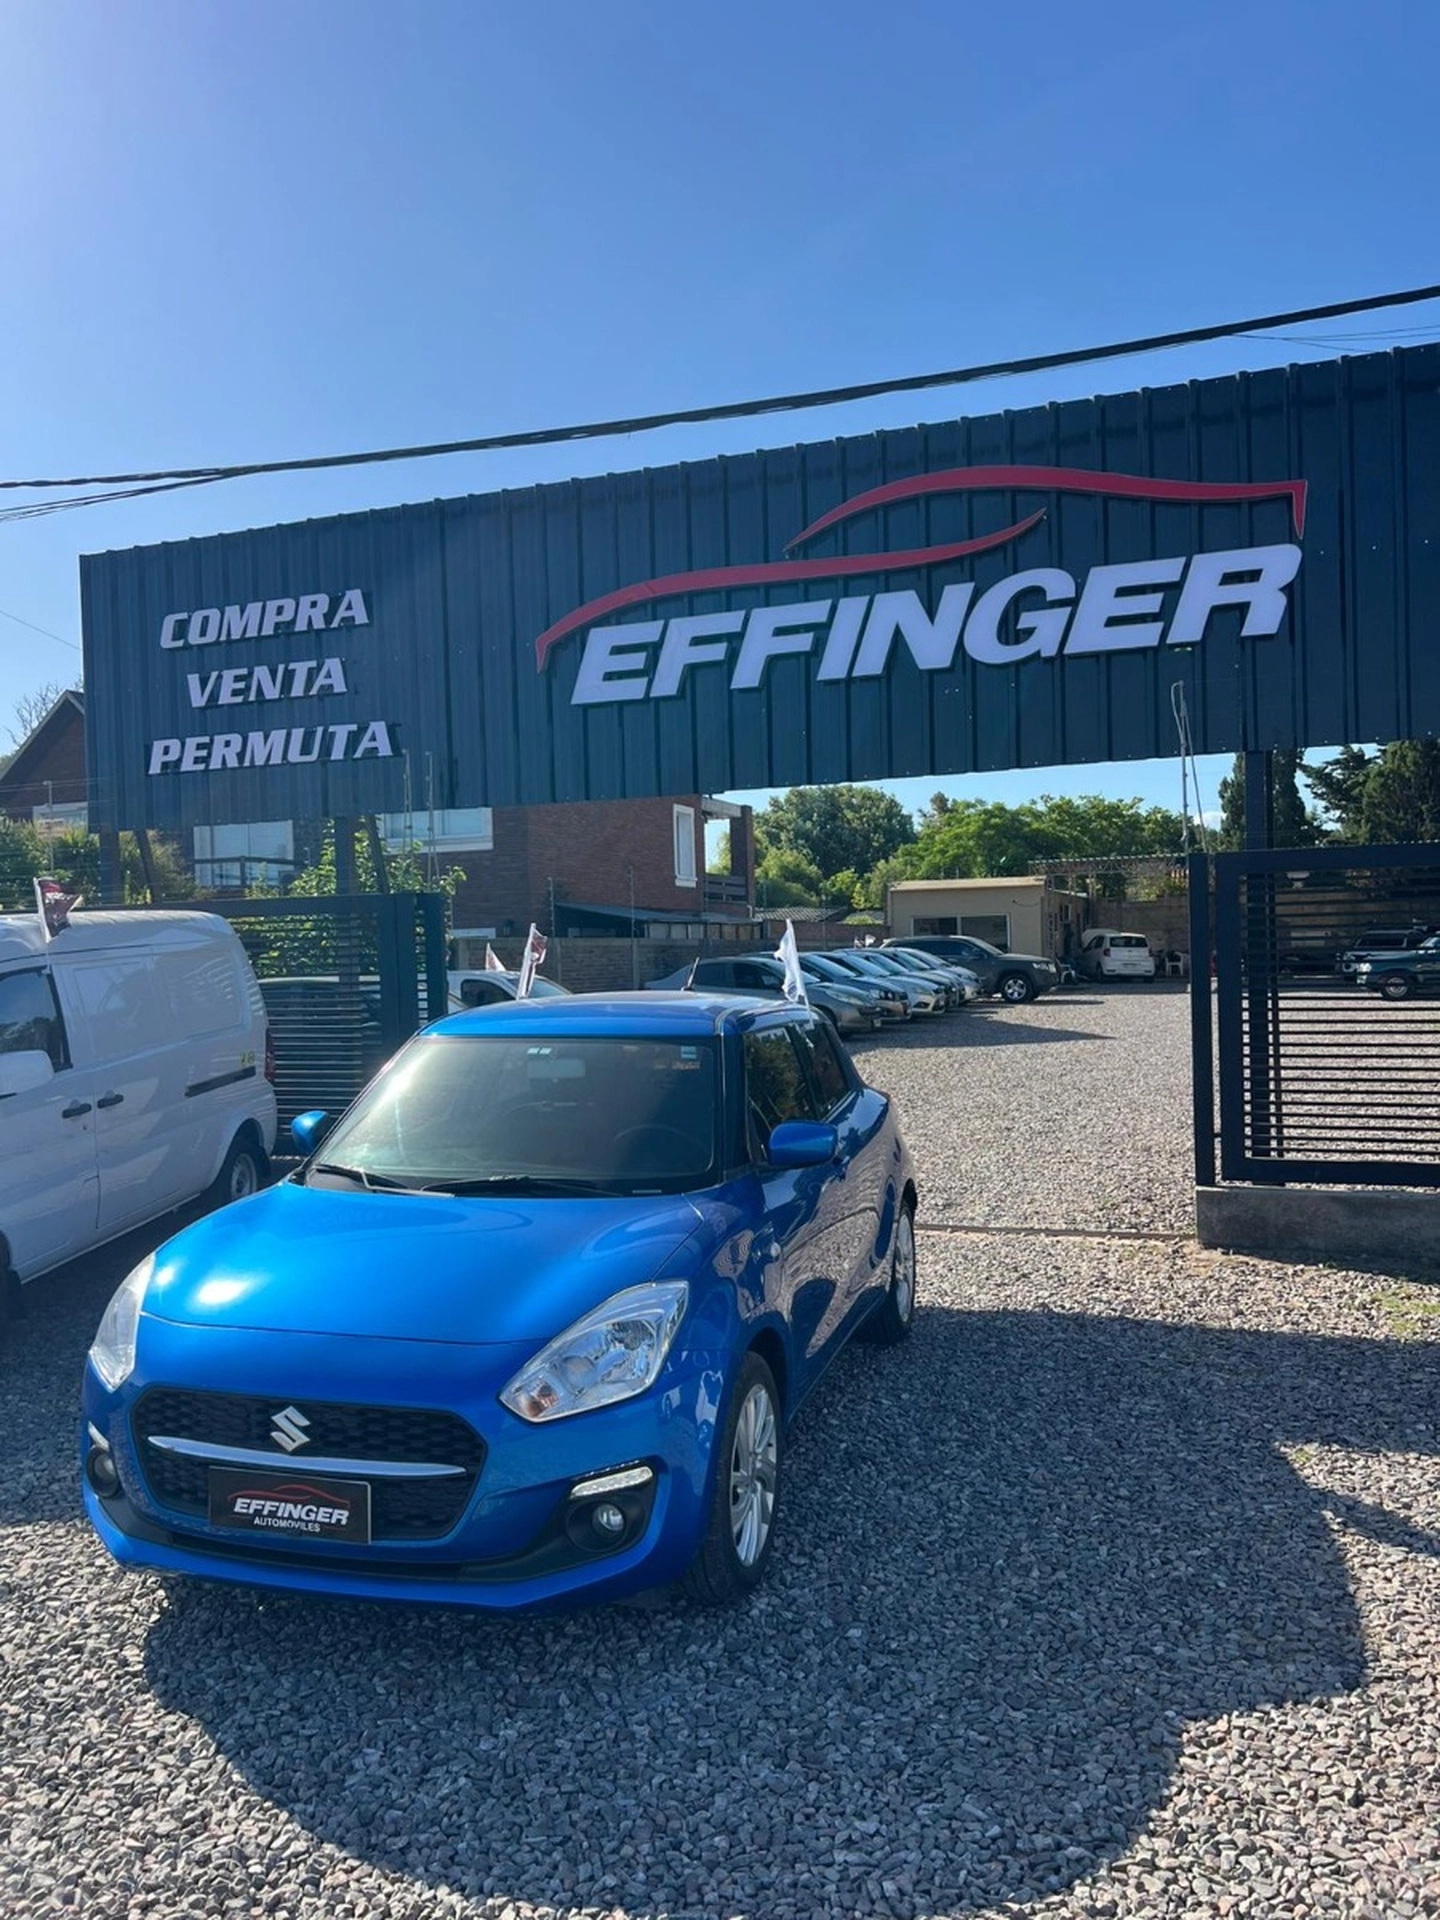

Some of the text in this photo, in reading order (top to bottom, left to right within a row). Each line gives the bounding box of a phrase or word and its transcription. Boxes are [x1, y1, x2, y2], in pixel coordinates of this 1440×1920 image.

[160, 588, 369, 649] COMPRA
[570, 544, 1302, 705] EFFINGER
[187, 657, 348, 708] VENTA
[148, 720, 393, 775] PERMUTA
[233, 1498, 350, 1525] EFFINGER
[253, 1516, 321, 1533] AUTOMOVILES
